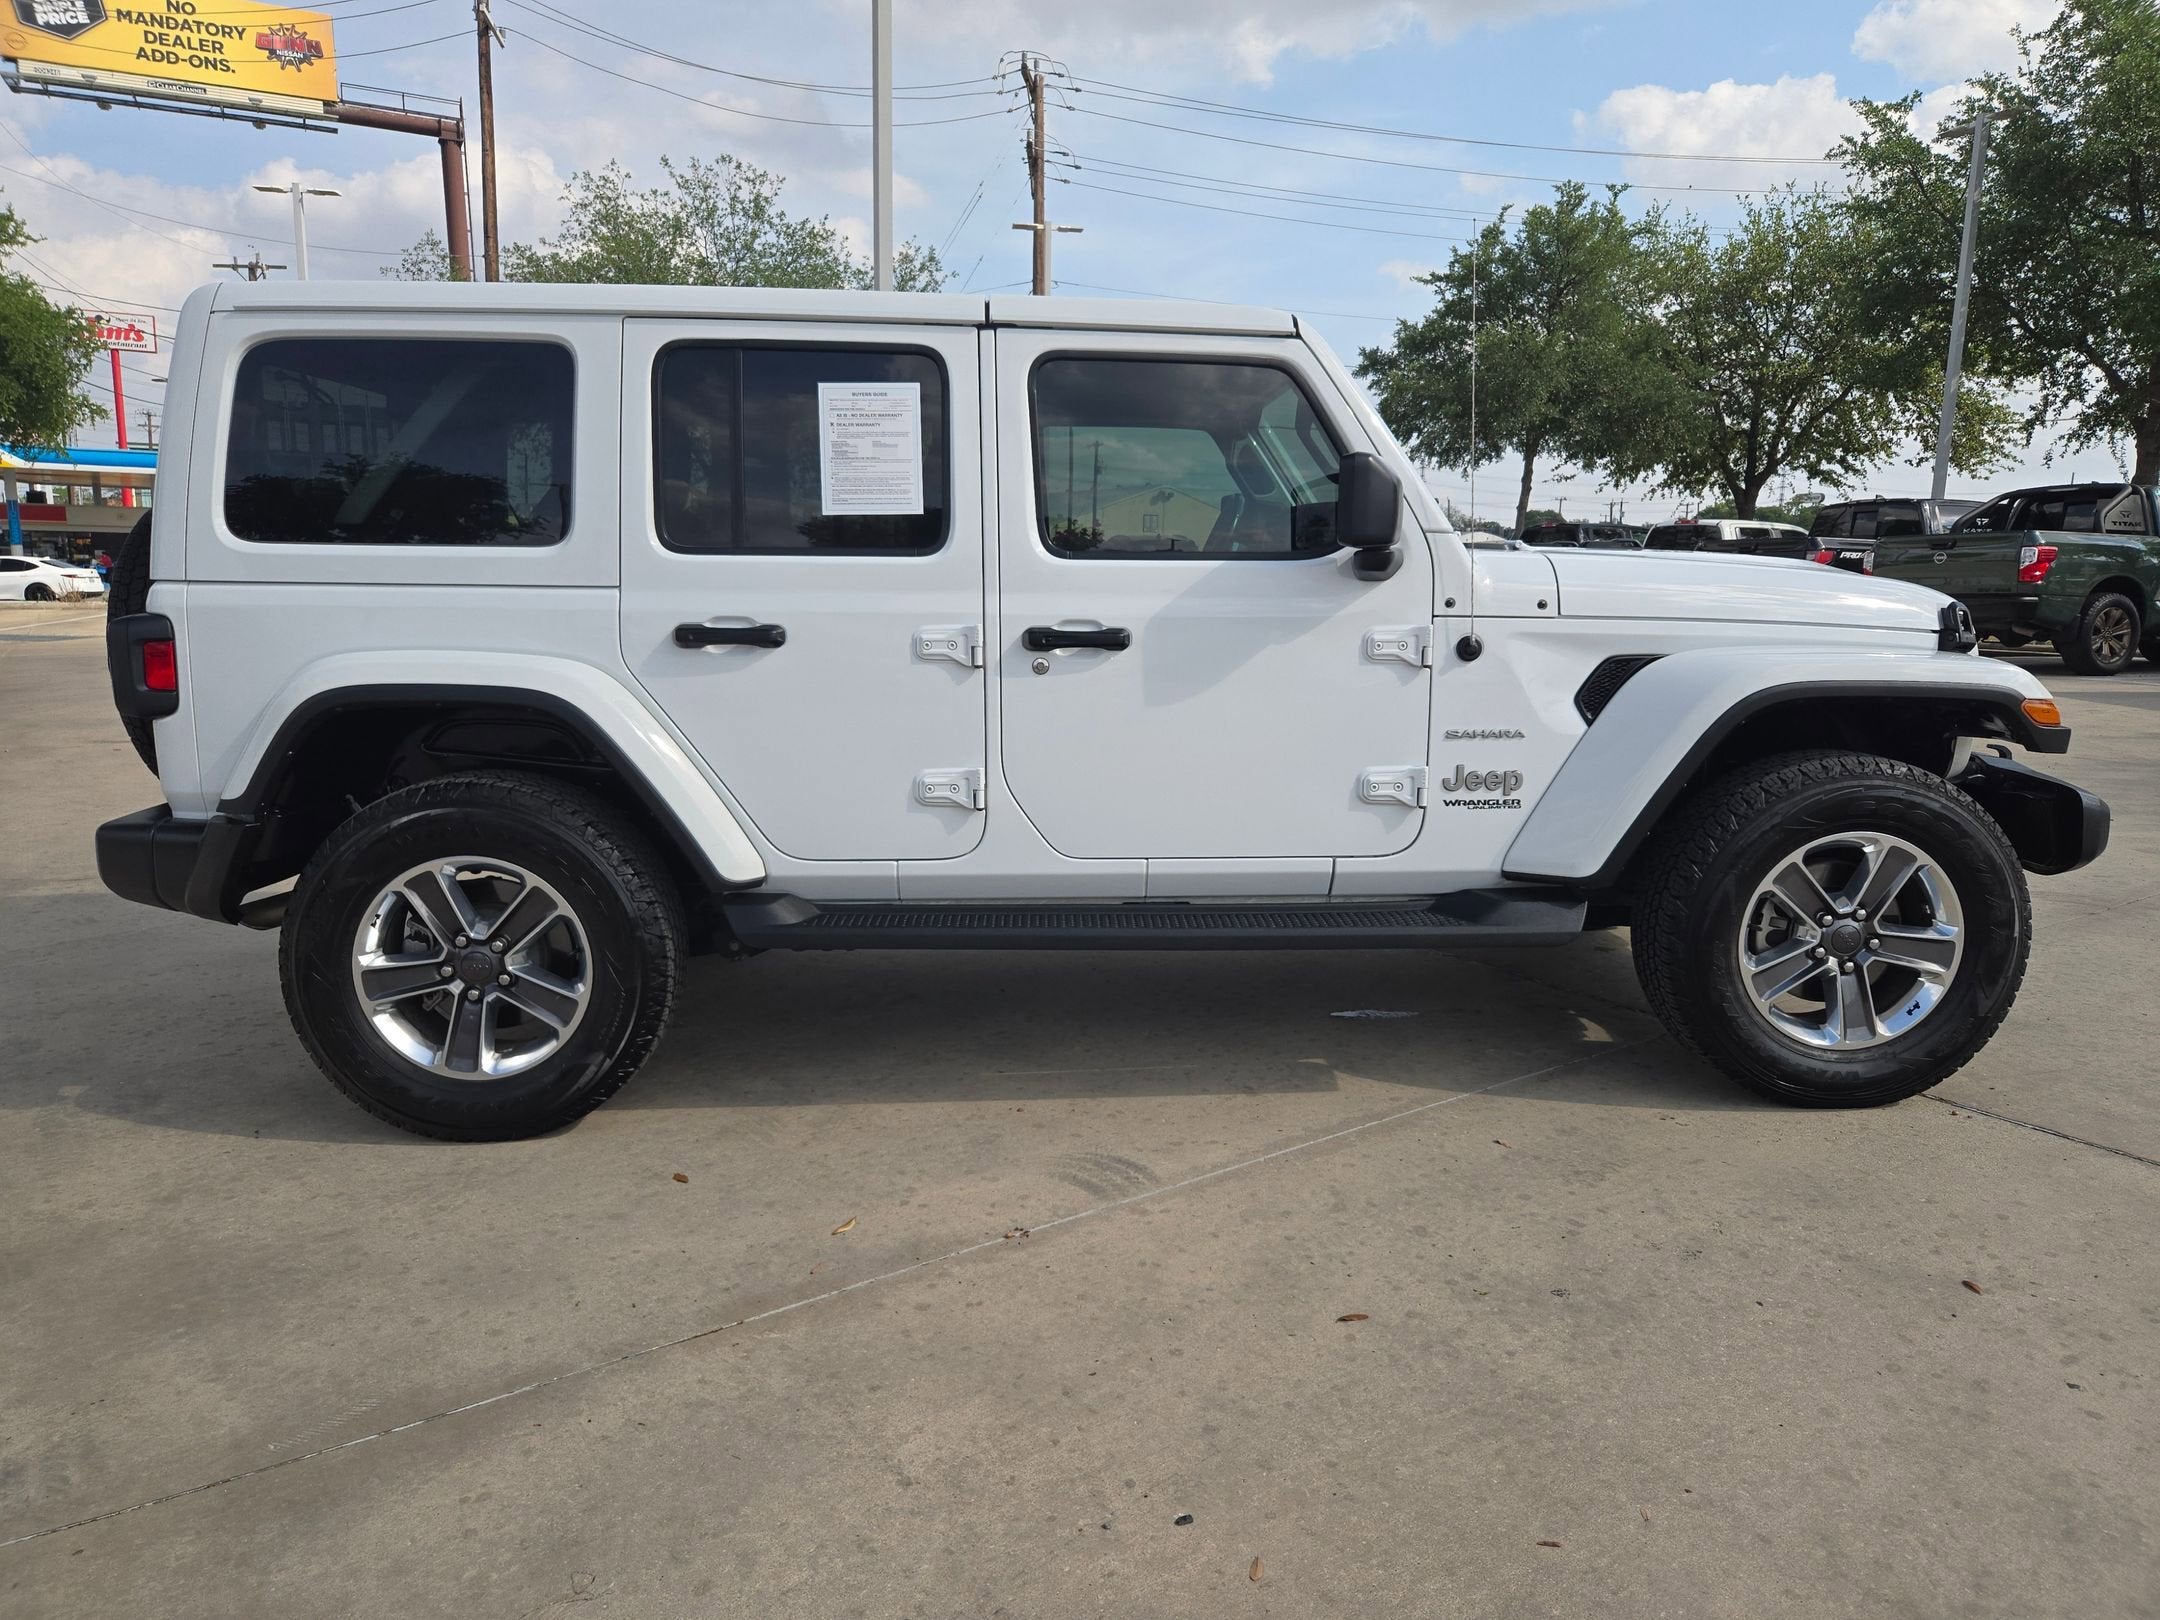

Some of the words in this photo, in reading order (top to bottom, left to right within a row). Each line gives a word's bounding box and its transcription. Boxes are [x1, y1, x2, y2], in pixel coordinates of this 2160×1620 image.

[166, 0, 197, 15] NO
[35, 11, 91, 26] PRICE
[116, 8, 246, 41] MANDATORY
[143, 30, 224, 55] DEALER
[136, 46, 236, 74] ADD-ONS.
[276, 49, 304, 58] NISSAN
[1444, 729, 1526, 740] SAHARA
[1442, 764, 1524, 797] Jeep
[1442, 799, 1522, 807] WRANGLER
